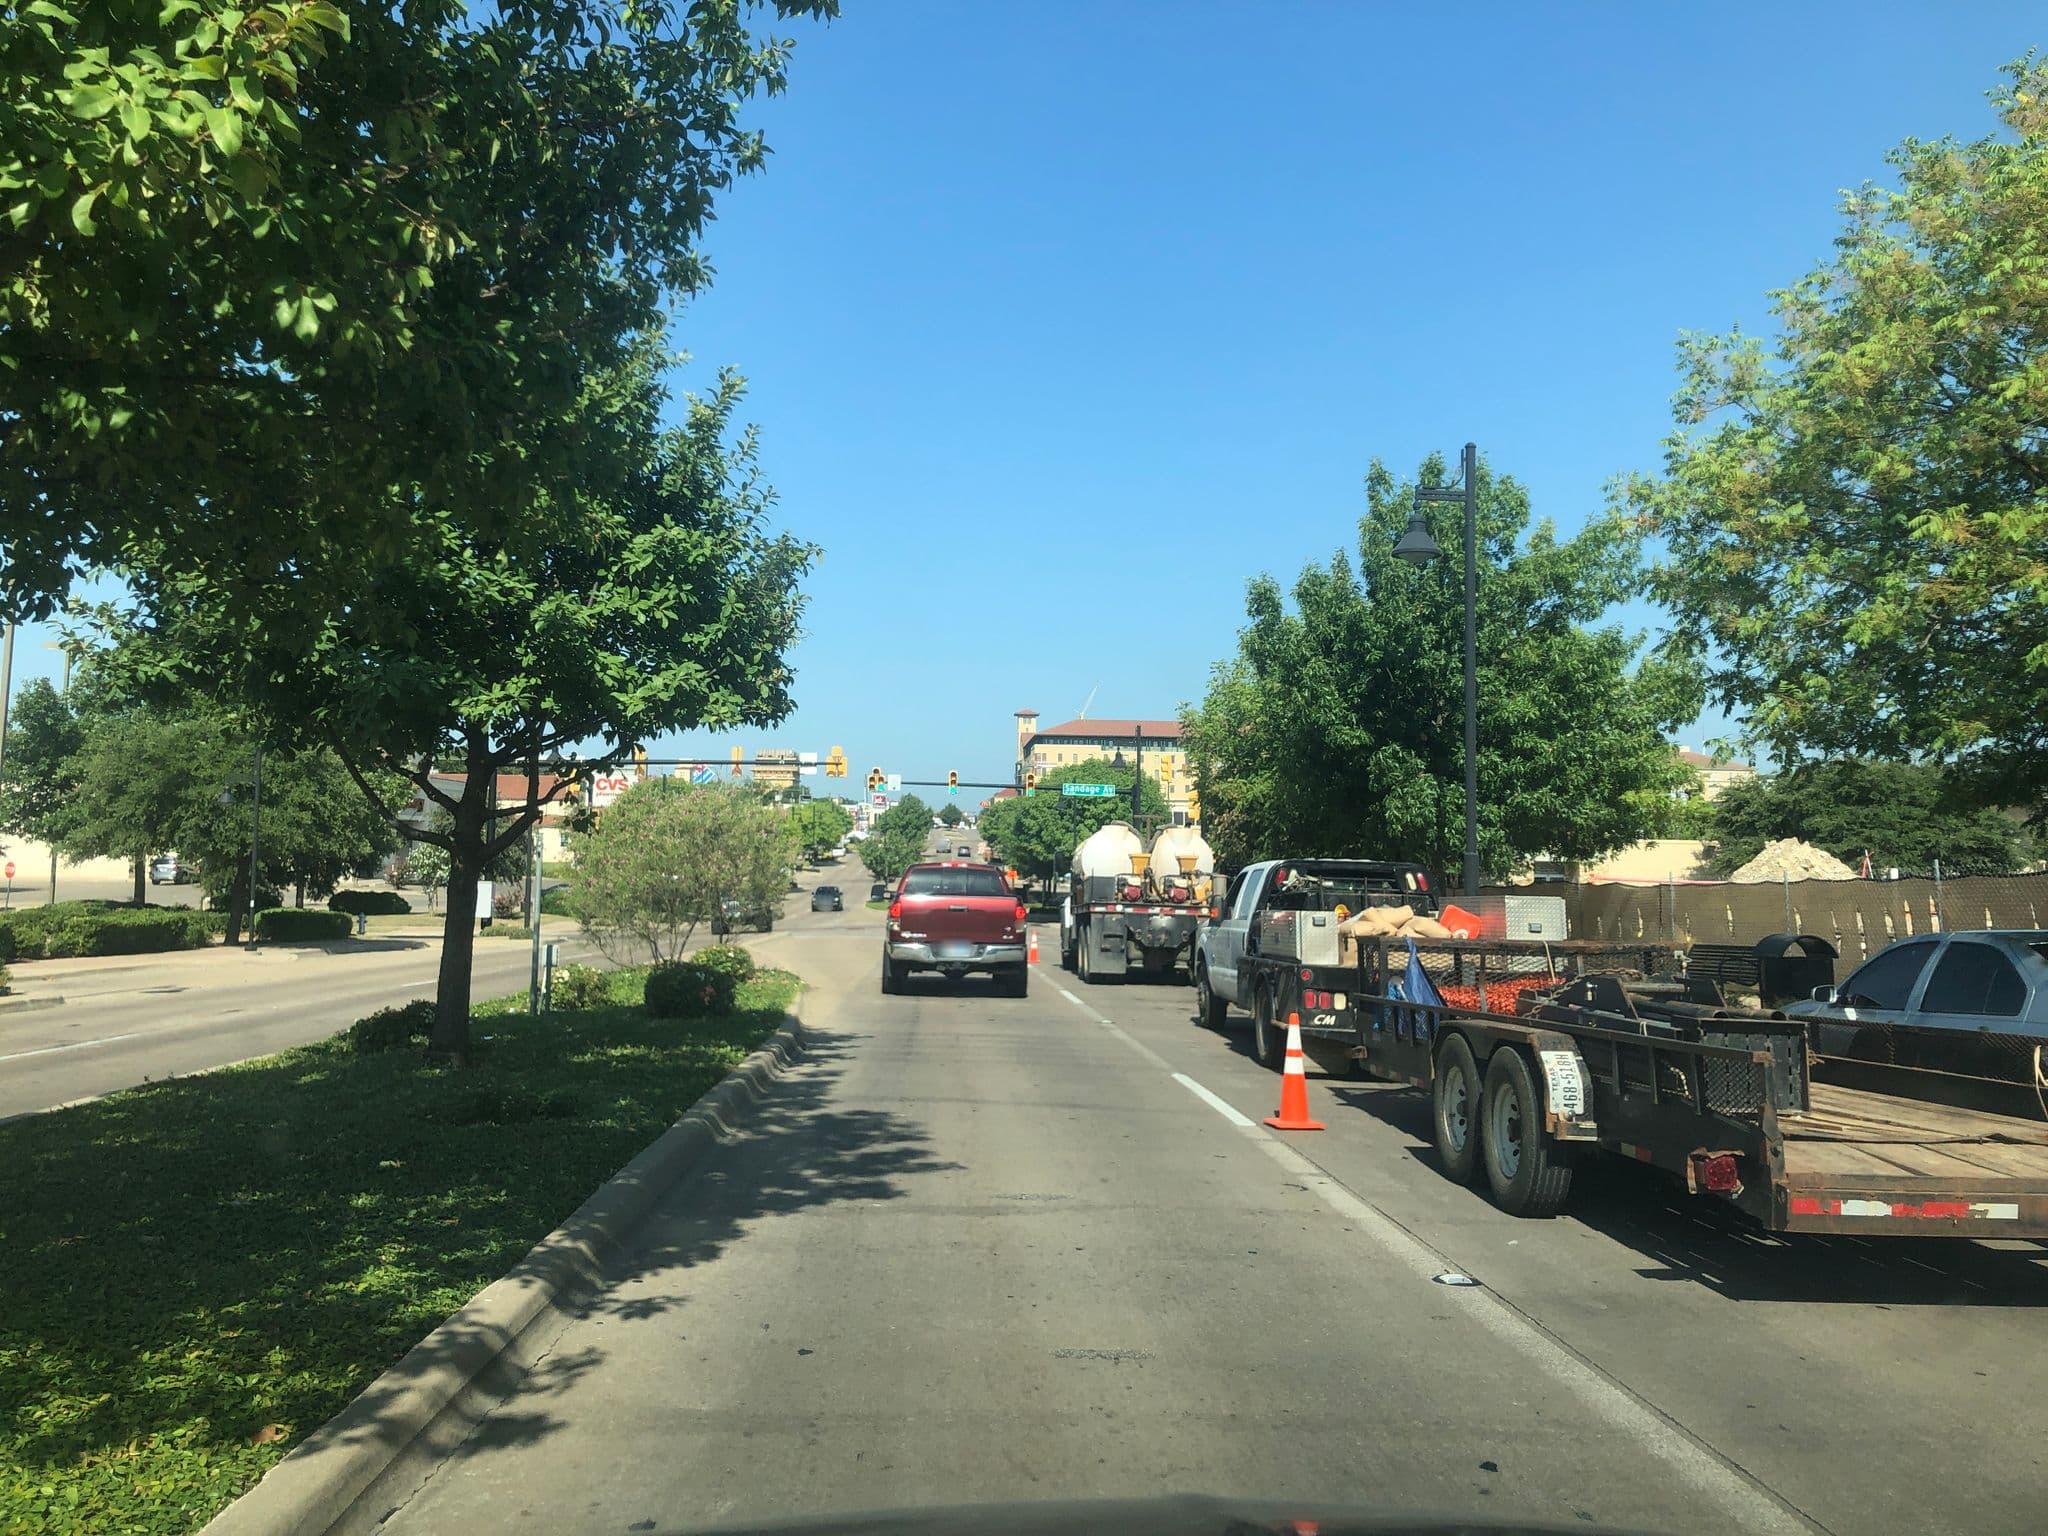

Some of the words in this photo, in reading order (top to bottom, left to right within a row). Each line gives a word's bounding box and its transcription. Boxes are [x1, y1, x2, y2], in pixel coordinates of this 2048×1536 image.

[595, 778, 629, 791] CVS
[1064, 784, 1100, 794] Sandage
[1313, 1014, 1337, 1026] CM
[1548, 1067, 1559, 1092] TEXAS
